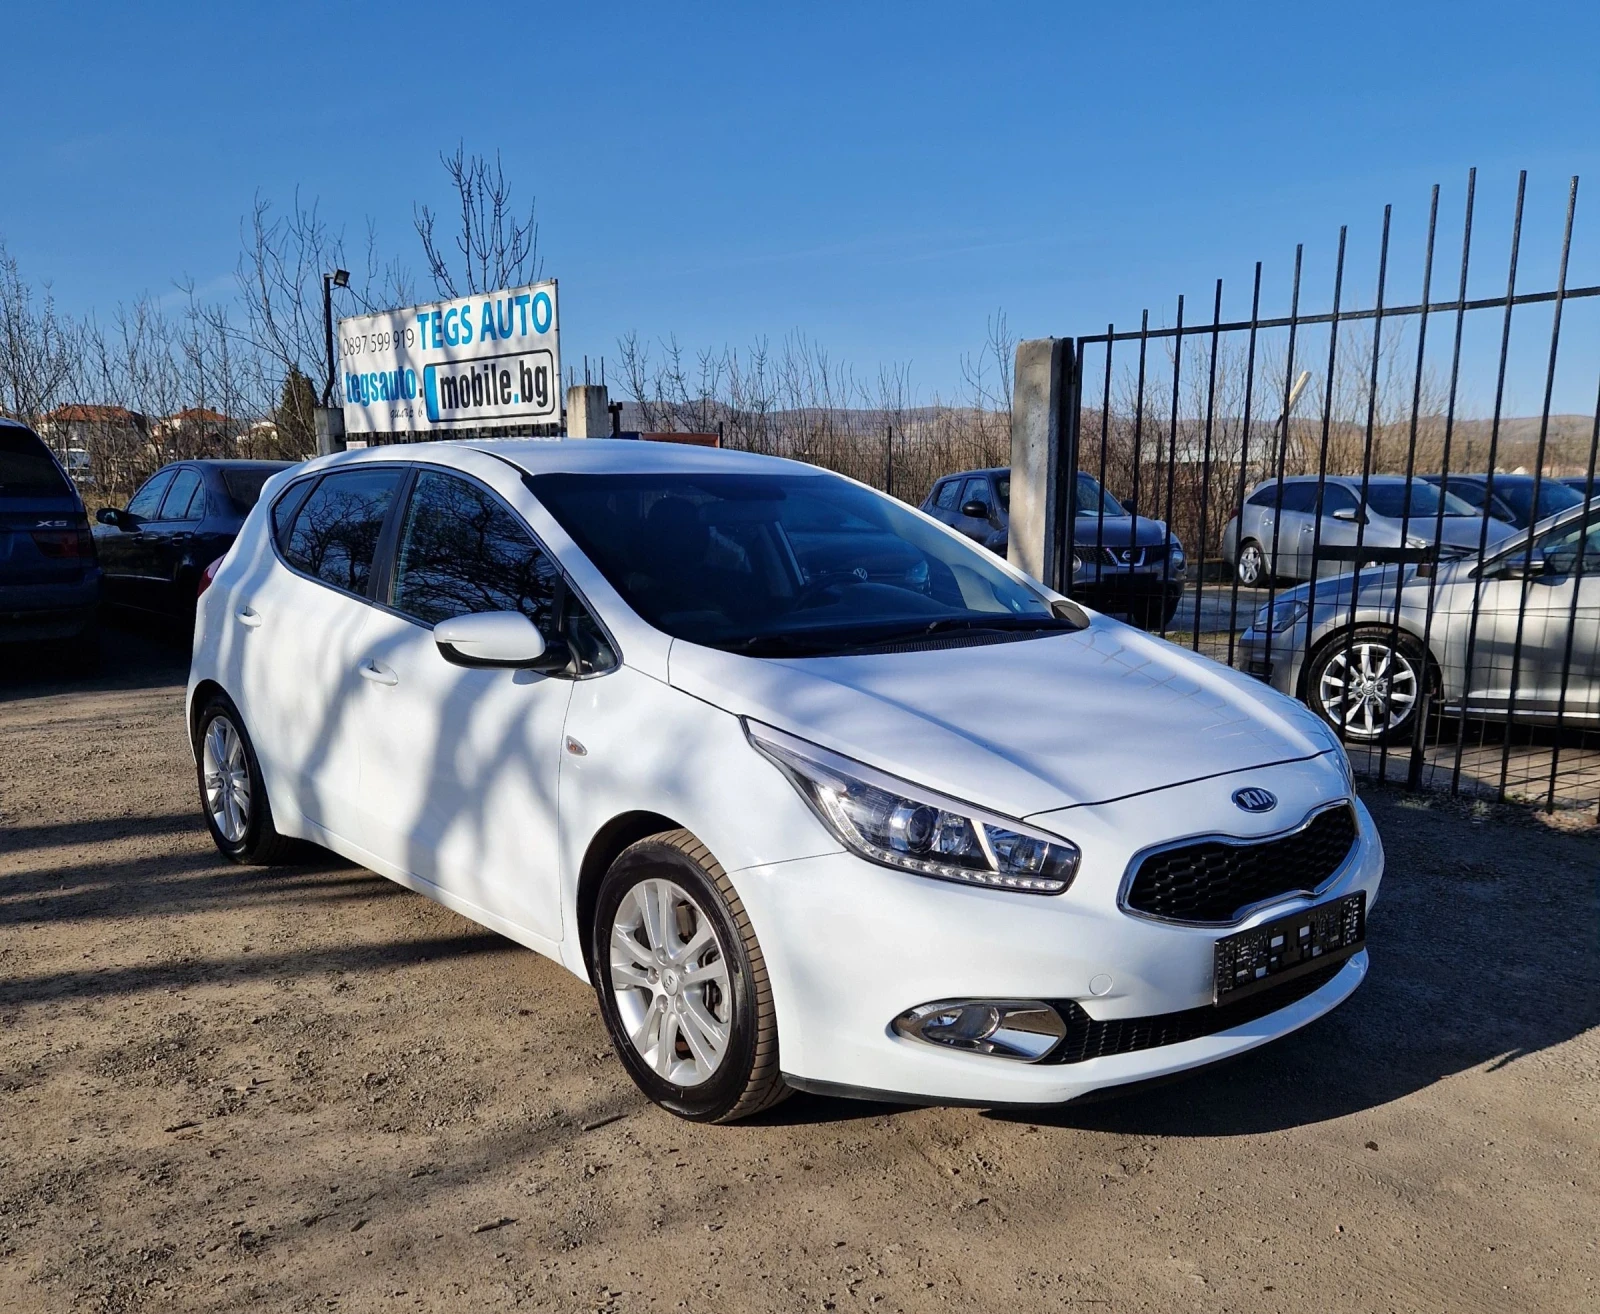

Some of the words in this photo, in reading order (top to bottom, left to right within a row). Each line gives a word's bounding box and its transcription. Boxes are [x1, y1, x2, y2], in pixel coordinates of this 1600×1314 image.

[417, 305, 473, 351] TEGS
[480, 292, 553, 342] AUTO
[343, 335, 368, 357] 0897
[370, 332, 391, 353] 599
[393, 328, 415, 350] 919
[440, 360, 548, 408] mobile.bg
[1237, 789, 1273, 807] KIA
